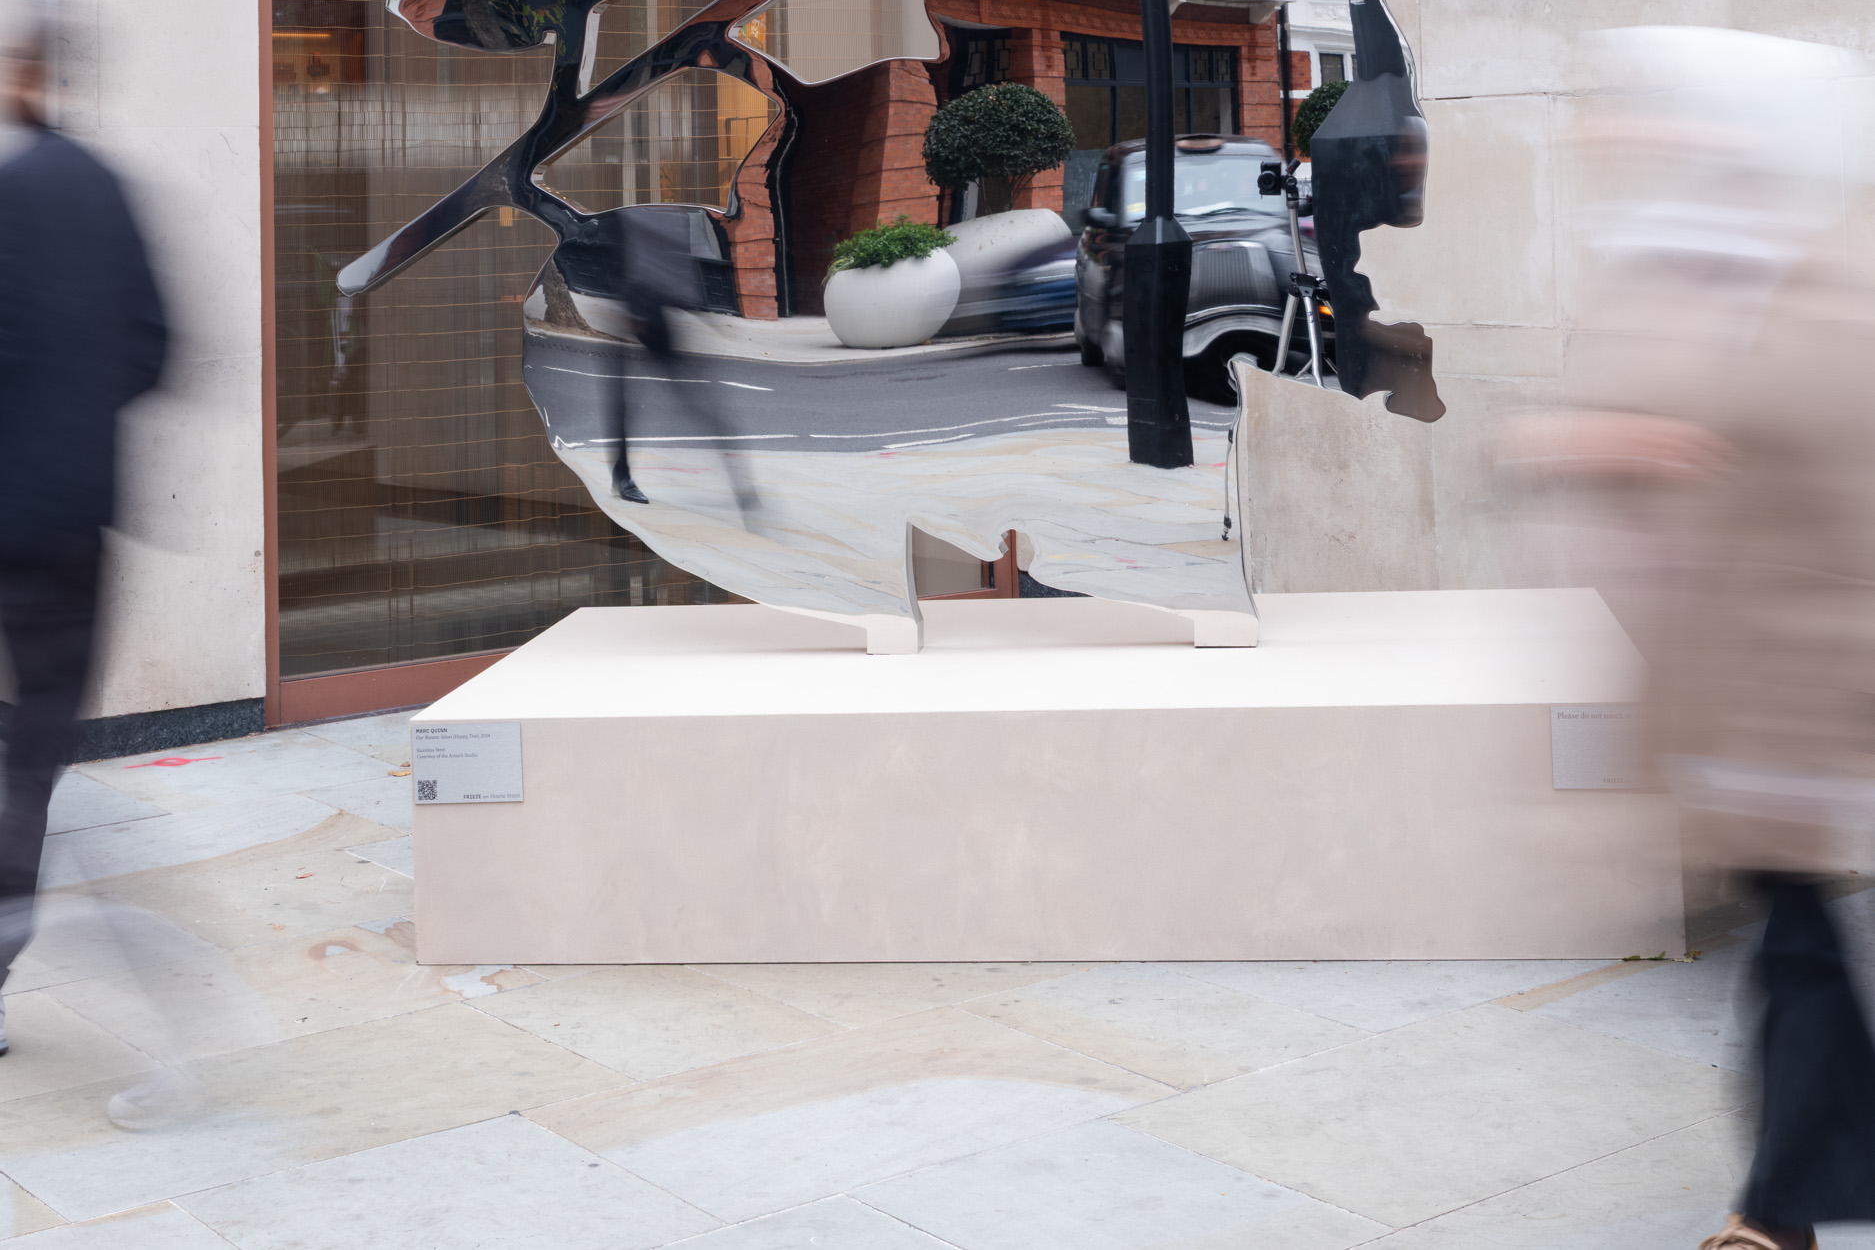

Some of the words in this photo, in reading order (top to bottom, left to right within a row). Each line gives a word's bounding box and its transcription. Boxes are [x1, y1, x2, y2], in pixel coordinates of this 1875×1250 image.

[1557, 711, 1579, 719] Please
[1580, 711, 1590, 719] do
[1603, 711, 1623, 719] touch
